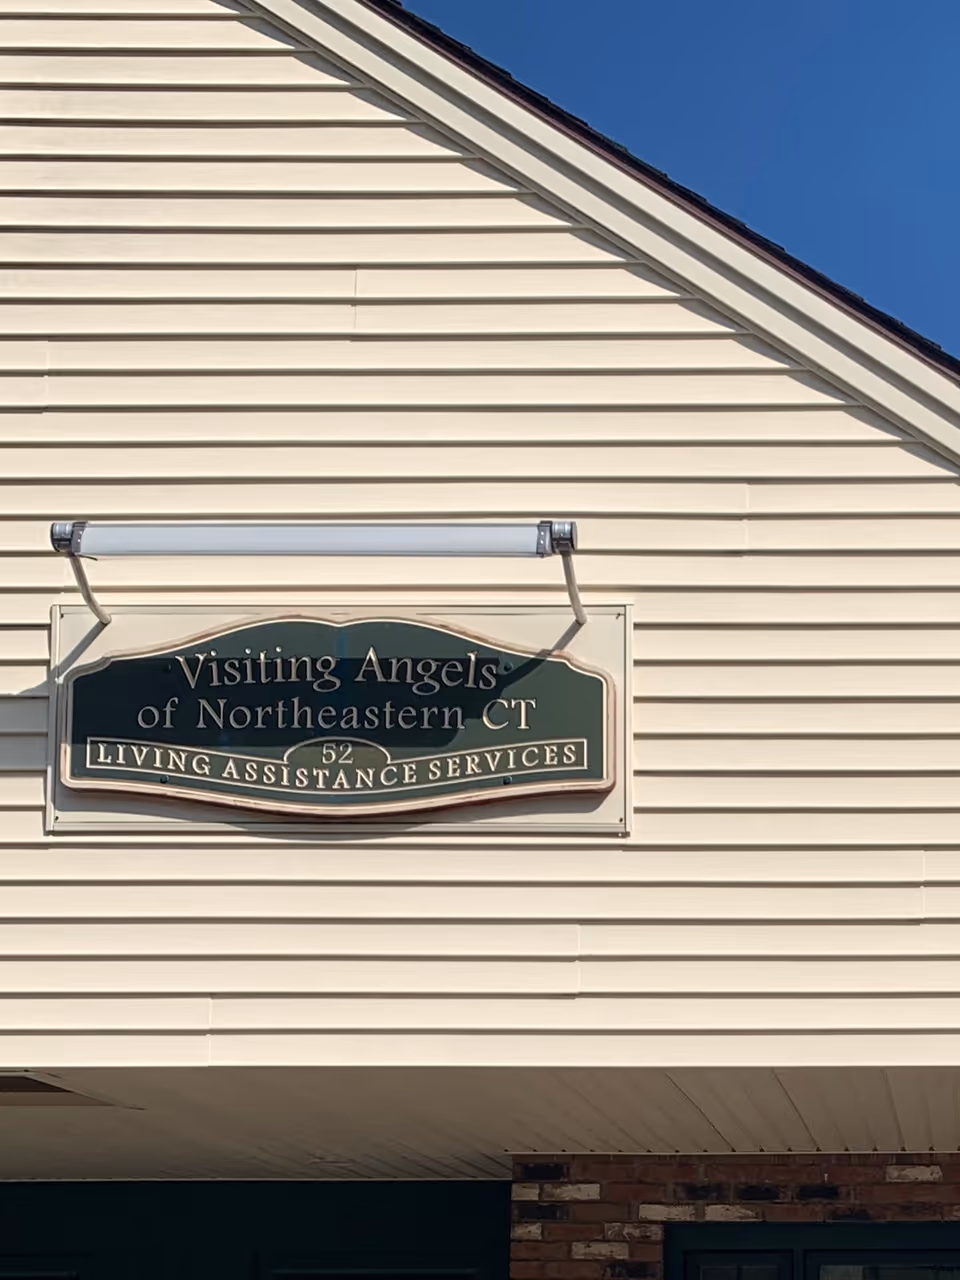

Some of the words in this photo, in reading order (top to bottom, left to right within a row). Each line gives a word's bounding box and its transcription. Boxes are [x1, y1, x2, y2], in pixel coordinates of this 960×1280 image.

[175, 646, 341, 692] Visiting
[354, 646, 497, 695] Angels
[137, 697, 178, 728] of
[195, 698, 465, 729] Northeastern
[482, 699, 536, 729] CT
[97, 743, 210, 775] LIVING
[222, 758, 417, 789] ASSISTANCE
[428, 744, 576, 780] SERVICES
[321, 742, 354, 764] 52
